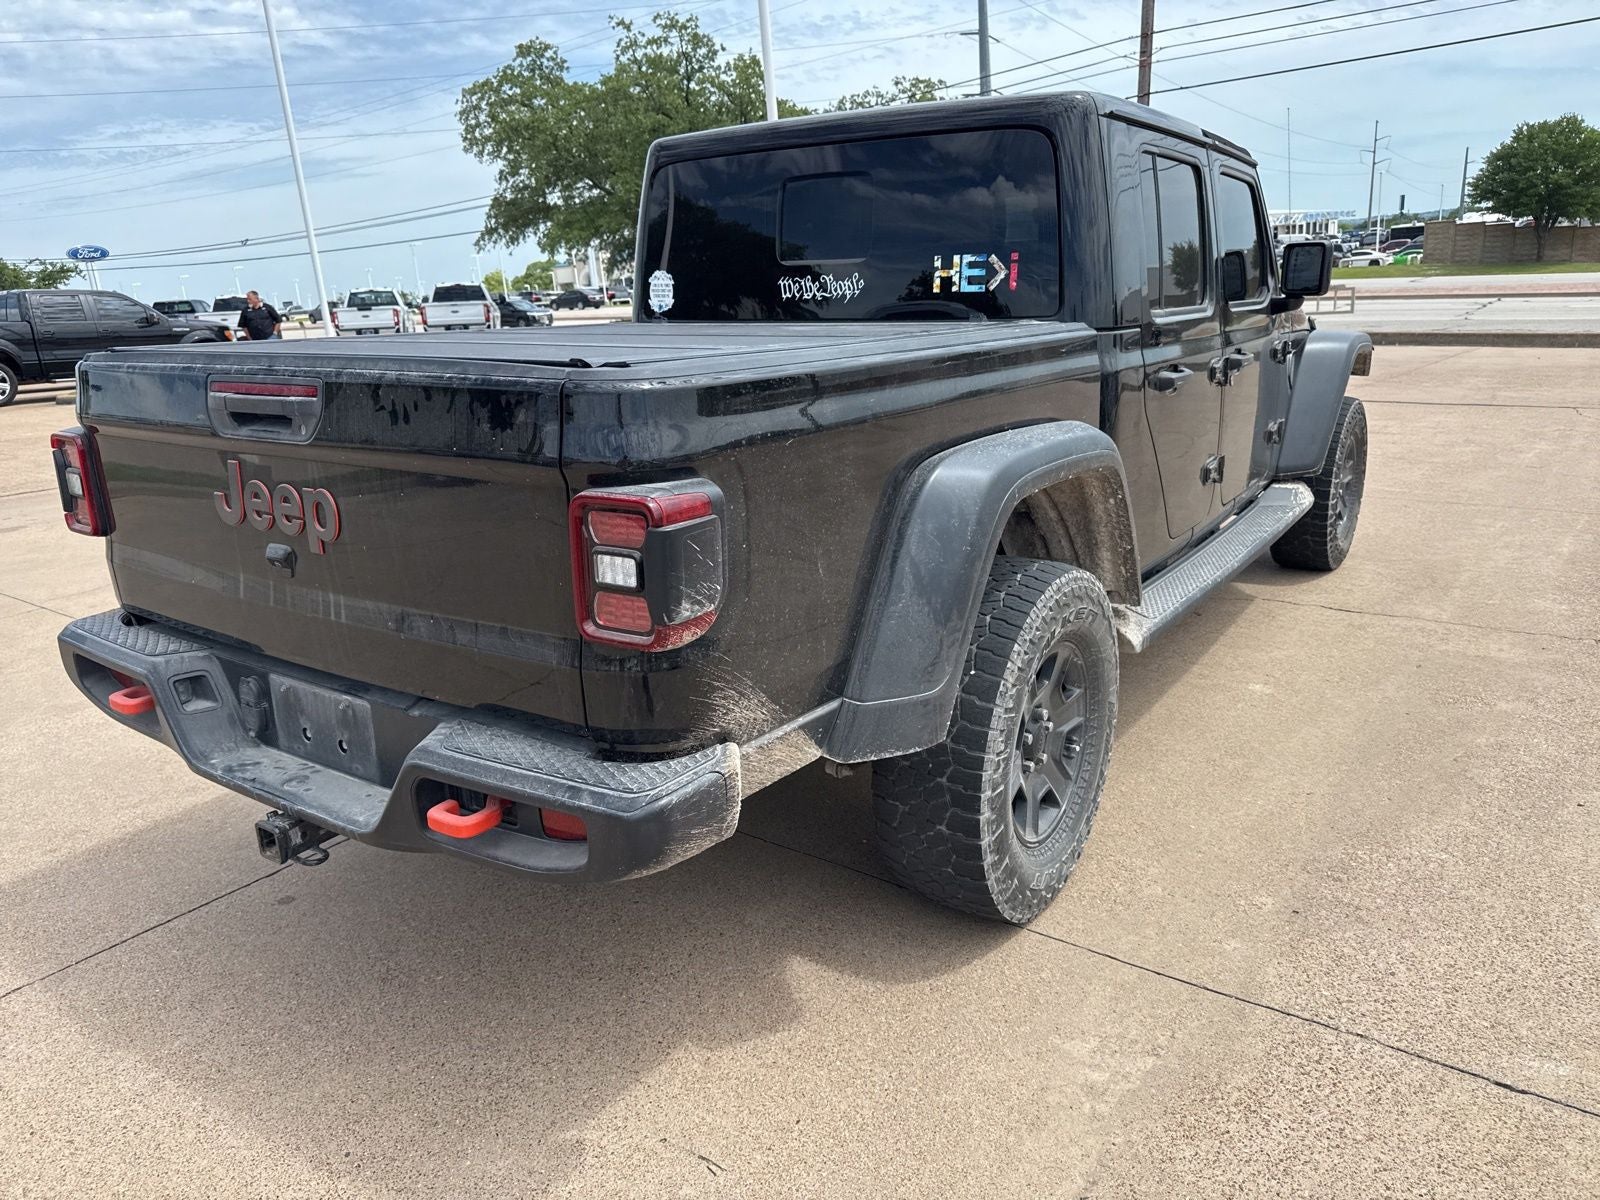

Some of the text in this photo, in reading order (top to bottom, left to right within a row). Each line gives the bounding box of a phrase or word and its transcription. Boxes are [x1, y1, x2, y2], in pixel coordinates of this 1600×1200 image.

[77, 247, 102, 259] Ford
[778, 276, 803, 302] We
[818, 272, 865, 304] People
[213, 459, 341, 555] Jeep
